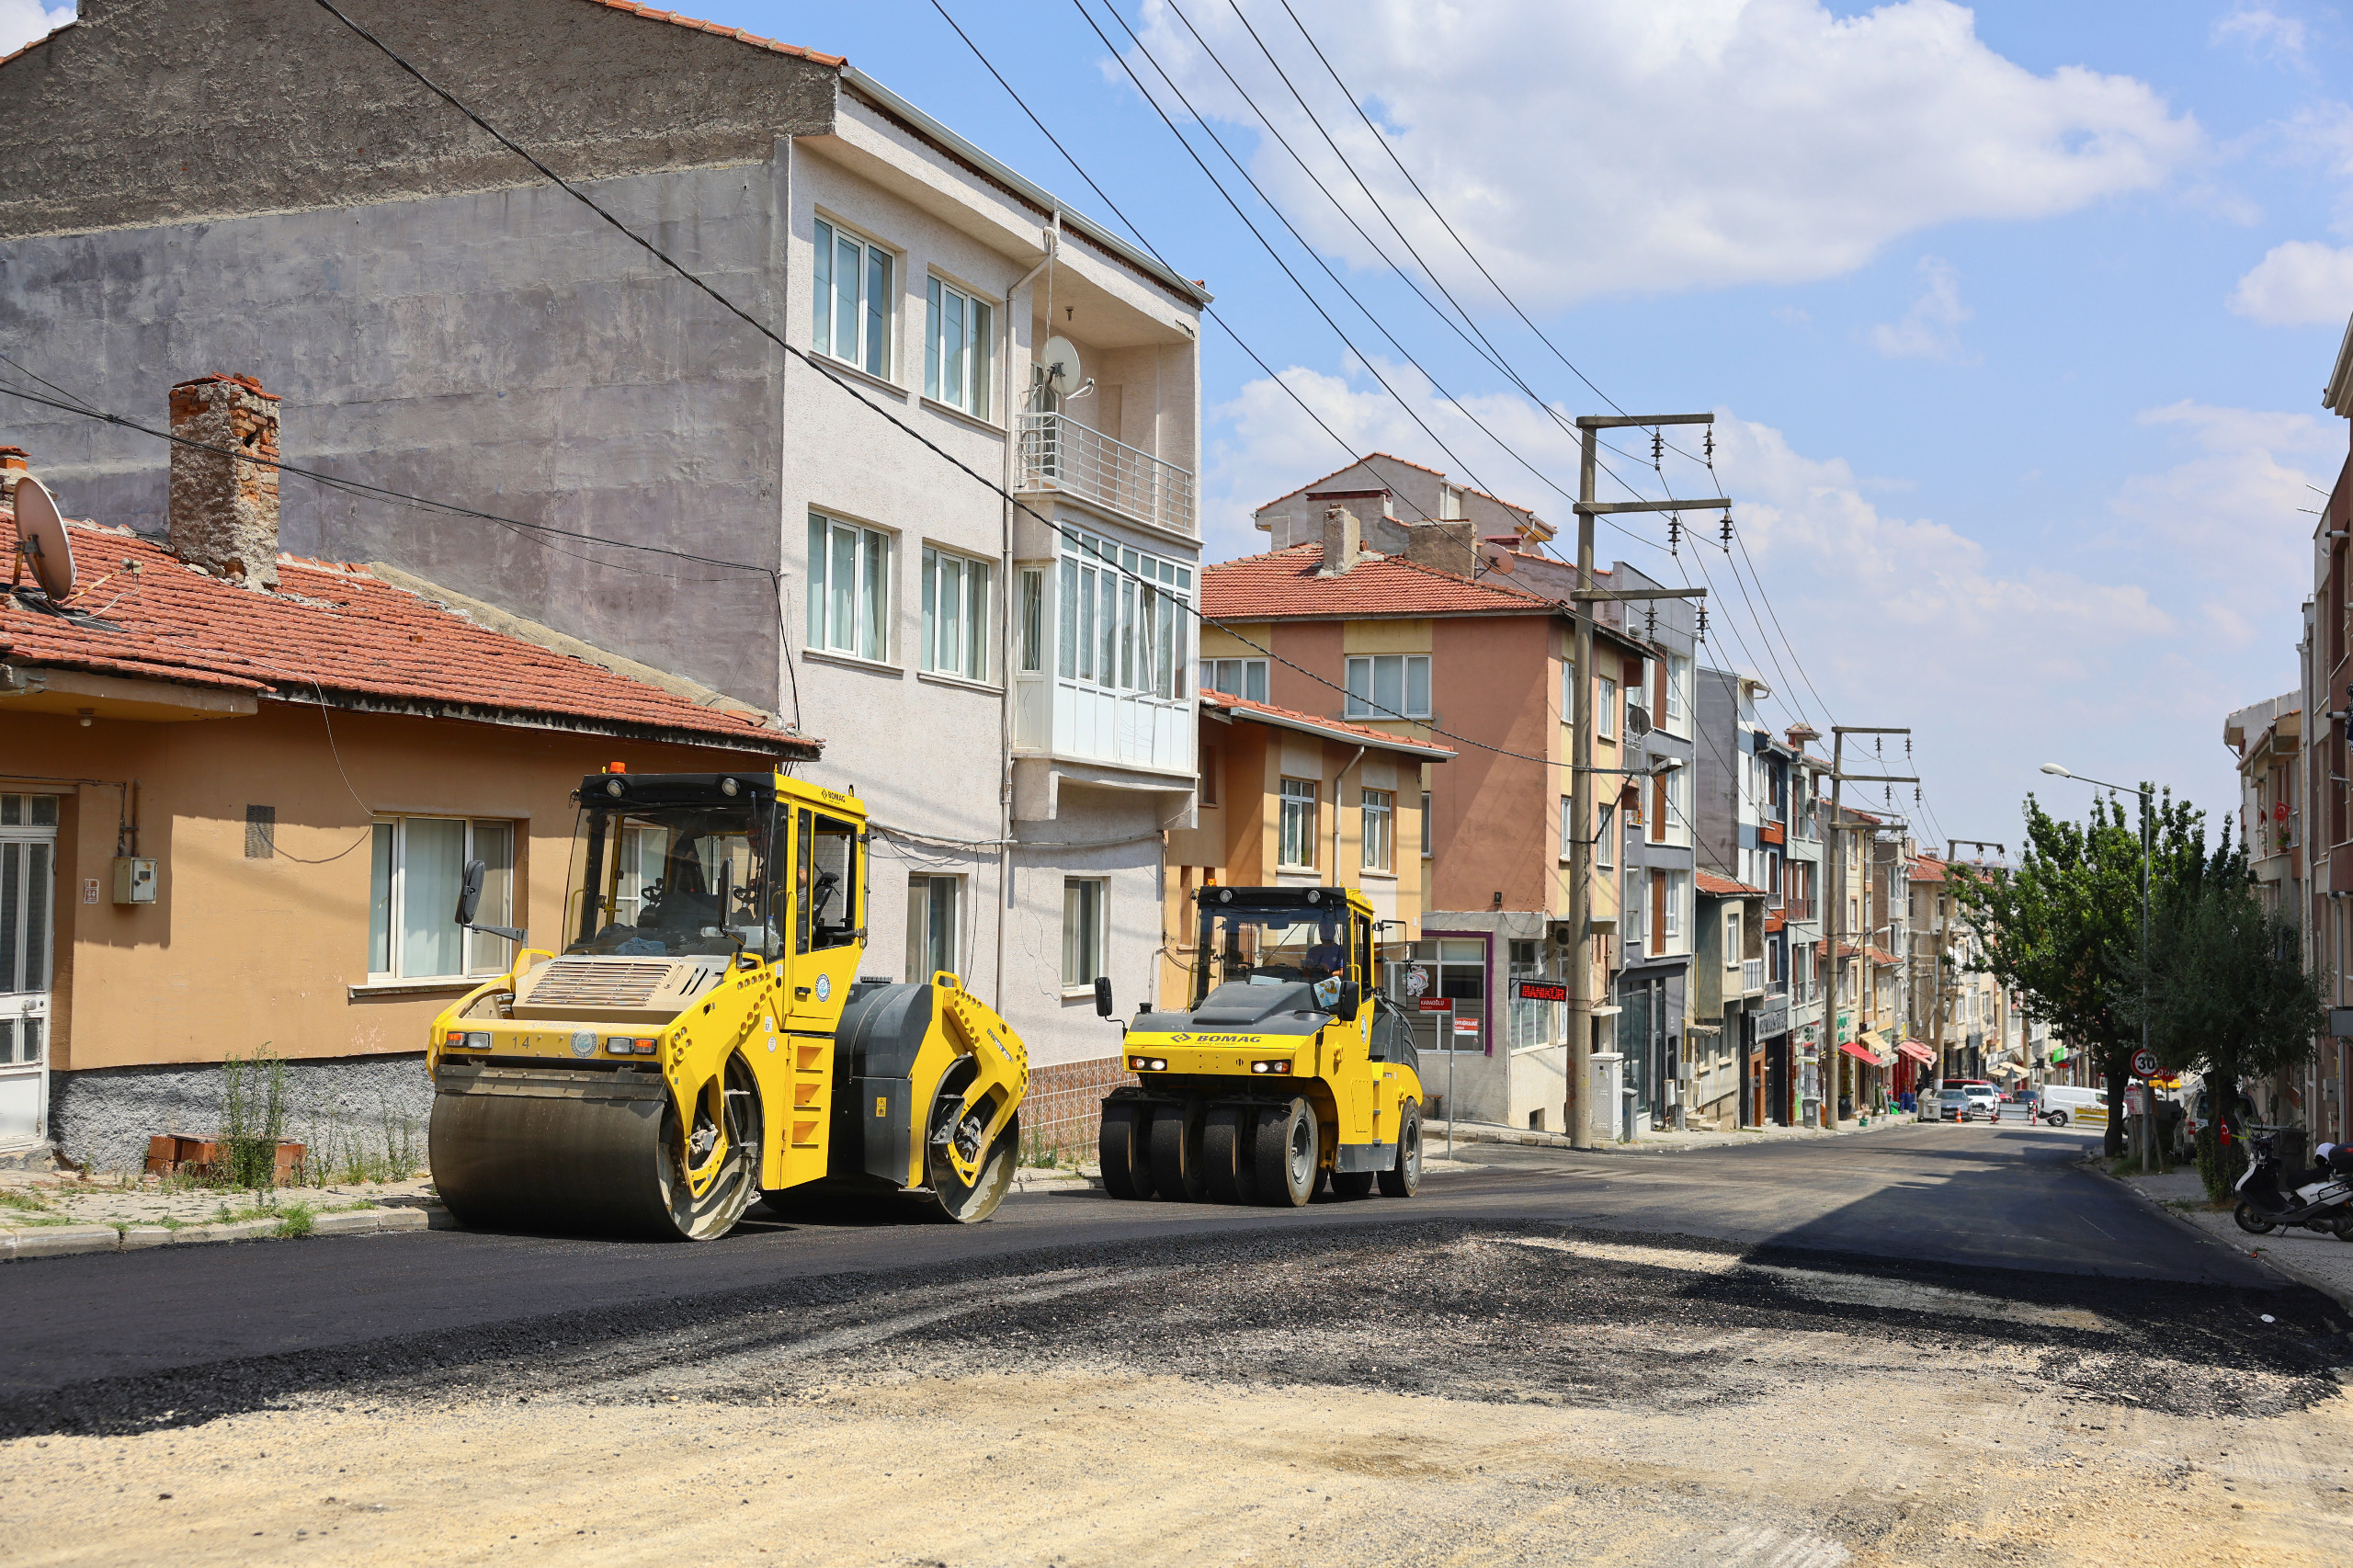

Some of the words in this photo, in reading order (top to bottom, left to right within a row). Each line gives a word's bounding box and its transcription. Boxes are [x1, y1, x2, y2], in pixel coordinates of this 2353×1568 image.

[827, 790, 846, 802] BOMAG
[512, 1036, 530, 1050] 14
[1197, 1035, 1262, 1043] BOMAG
[2137, 1056, 2155, 1070] 30
